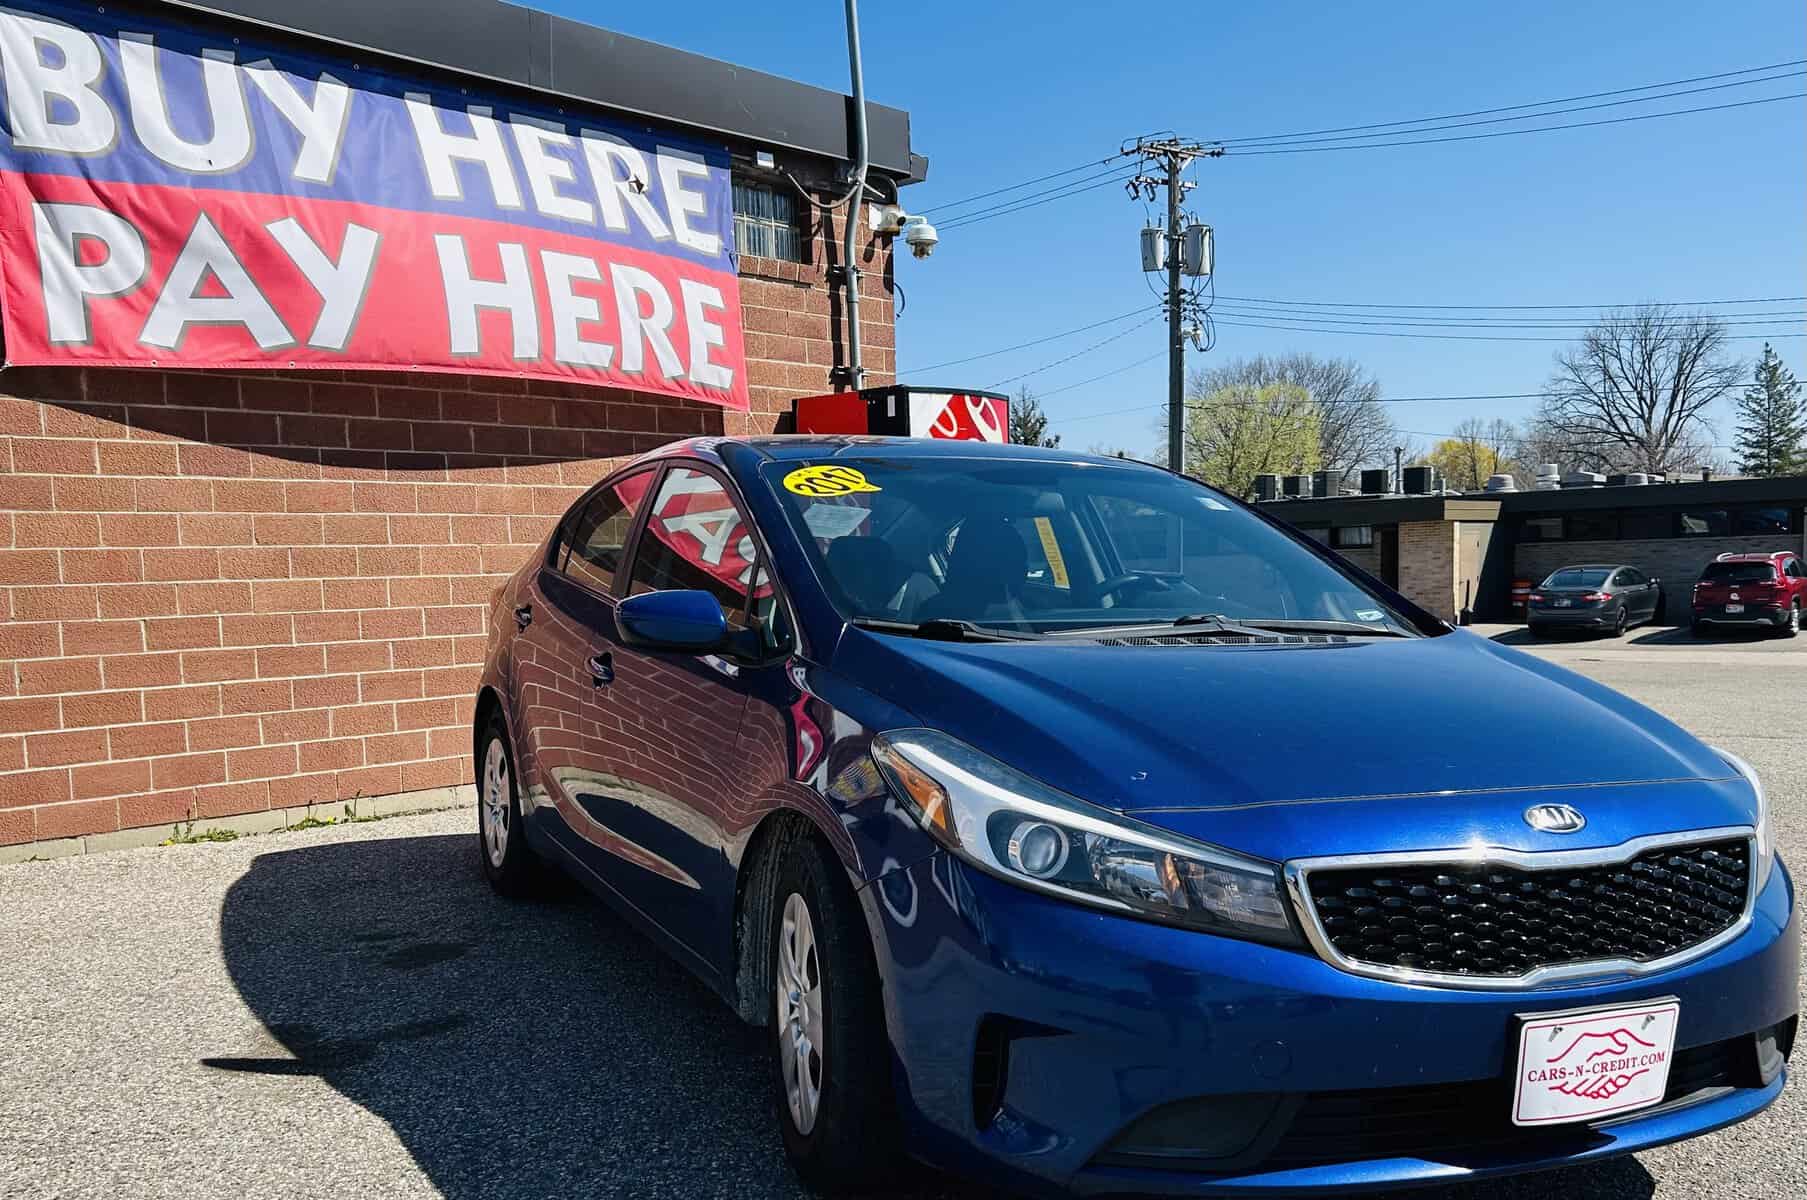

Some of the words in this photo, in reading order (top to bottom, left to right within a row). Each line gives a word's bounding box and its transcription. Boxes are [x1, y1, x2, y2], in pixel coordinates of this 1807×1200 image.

[0, 8, 351, 186] BUY
[404, 92, 723, 257] HERE
[32, 200, 382, 352] PAY
[435, 234, 734, 391] HERE
[794, 467, 863, 494] 2017
[1527, 1052, 1666, 1083] CARS-N-CREDIT.COM
